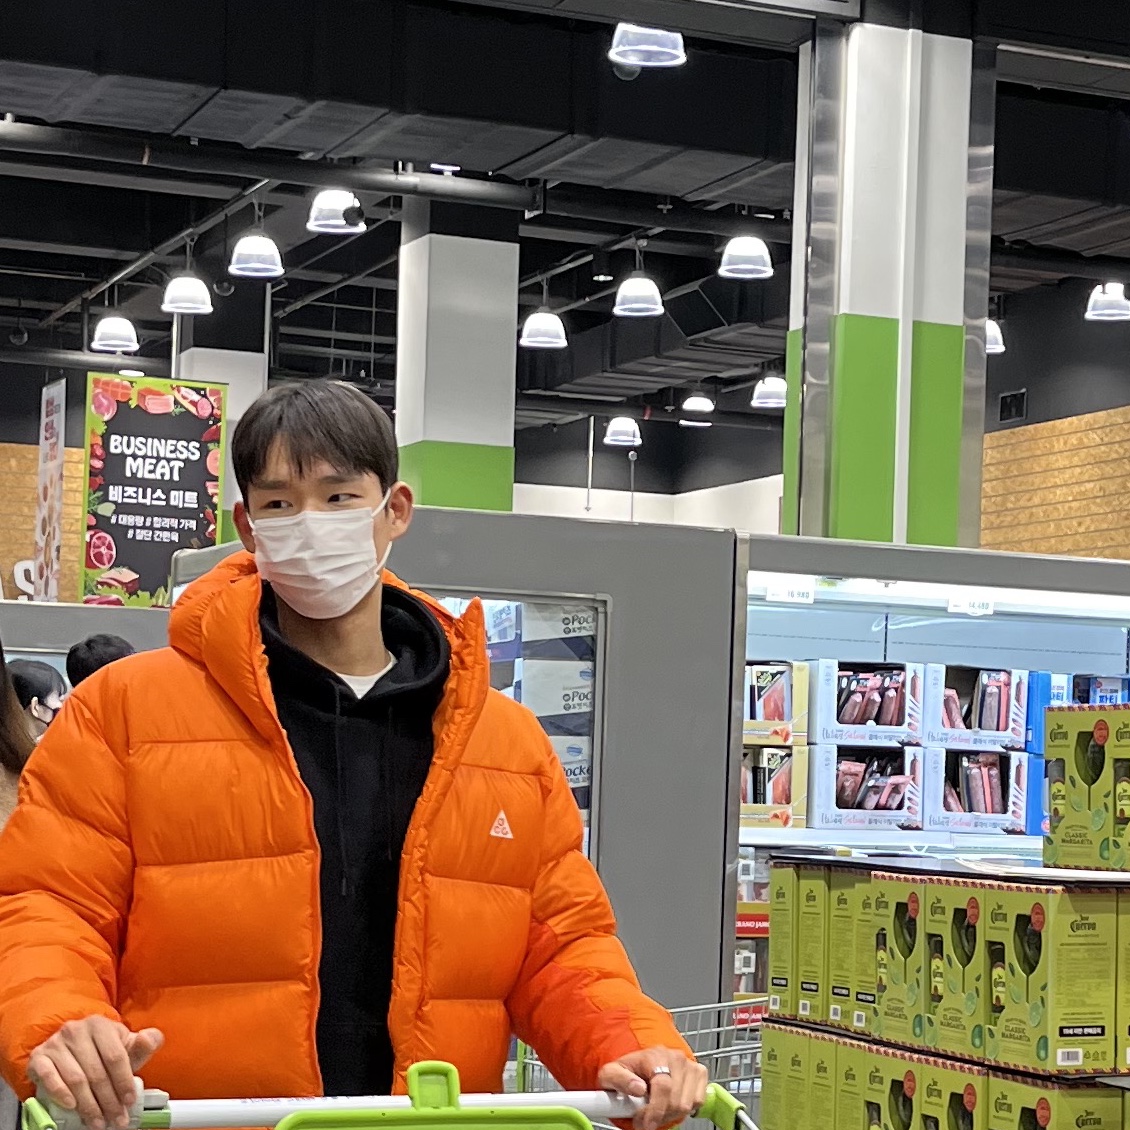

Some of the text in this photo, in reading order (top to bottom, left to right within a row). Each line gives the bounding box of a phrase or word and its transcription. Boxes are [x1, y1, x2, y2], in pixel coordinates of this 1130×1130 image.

[110, 434, 200, 461] BUSINESS
[125, 457, 184, 481] MEAT
[109, 485, 199, 509] 비즈니스 미트
